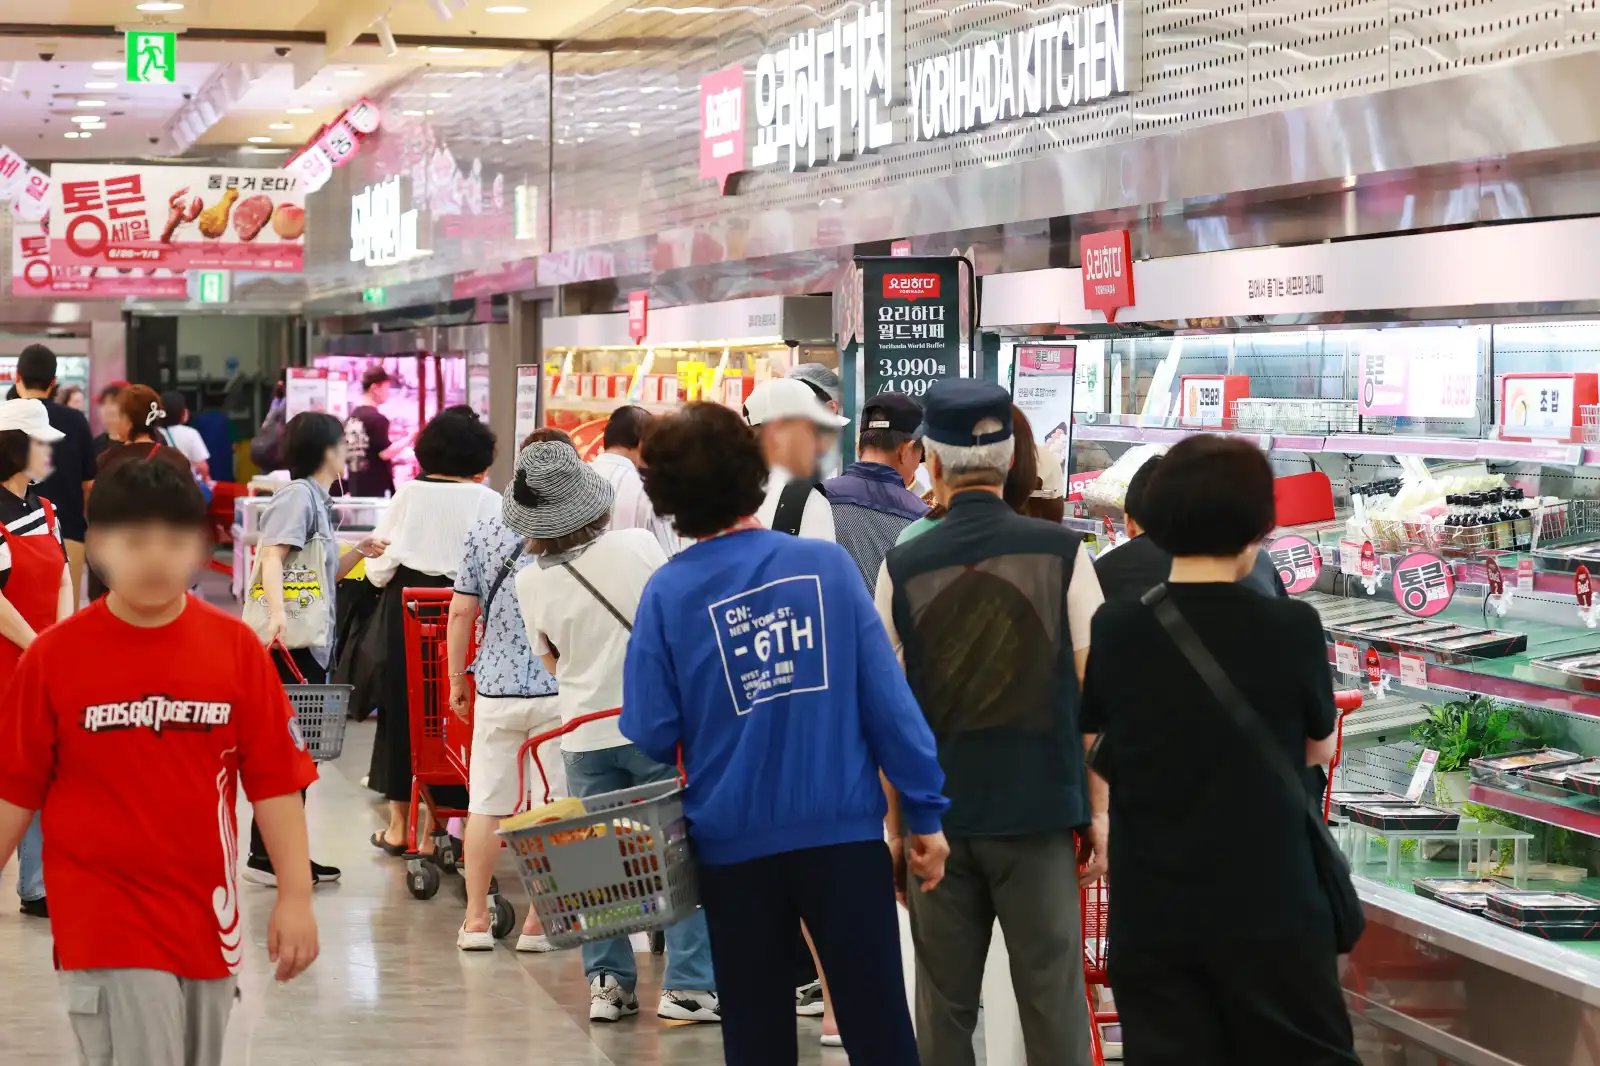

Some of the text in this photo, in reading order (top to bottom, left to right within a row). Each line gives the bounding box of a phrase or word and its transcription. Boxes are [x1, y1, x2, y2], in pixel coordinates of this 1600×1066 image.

[909, 0, 1125, 141] YORIHADA KITCHEN
[62, 174, 145, 257] 통큰
[112, 226, 150, 248] 세일
[1086, 244, 1122, 281] 요리하다
[888, 277, 935, 291] 요리하다
[877, 304, 946, 323] 요리하다
[877, 323, 946, 341] 월드뷔페
[907, 342, 926, 350] World
[926, 341, 945, 350] Buffet
[1269, 543, 1315, 589] 통큰
[1400, 560, 1445, 611] 통큰
[725, 604, 752, 624] CN:
[728, 622, 751, 637] NEW
[752, 611, 775, 629] YORK
